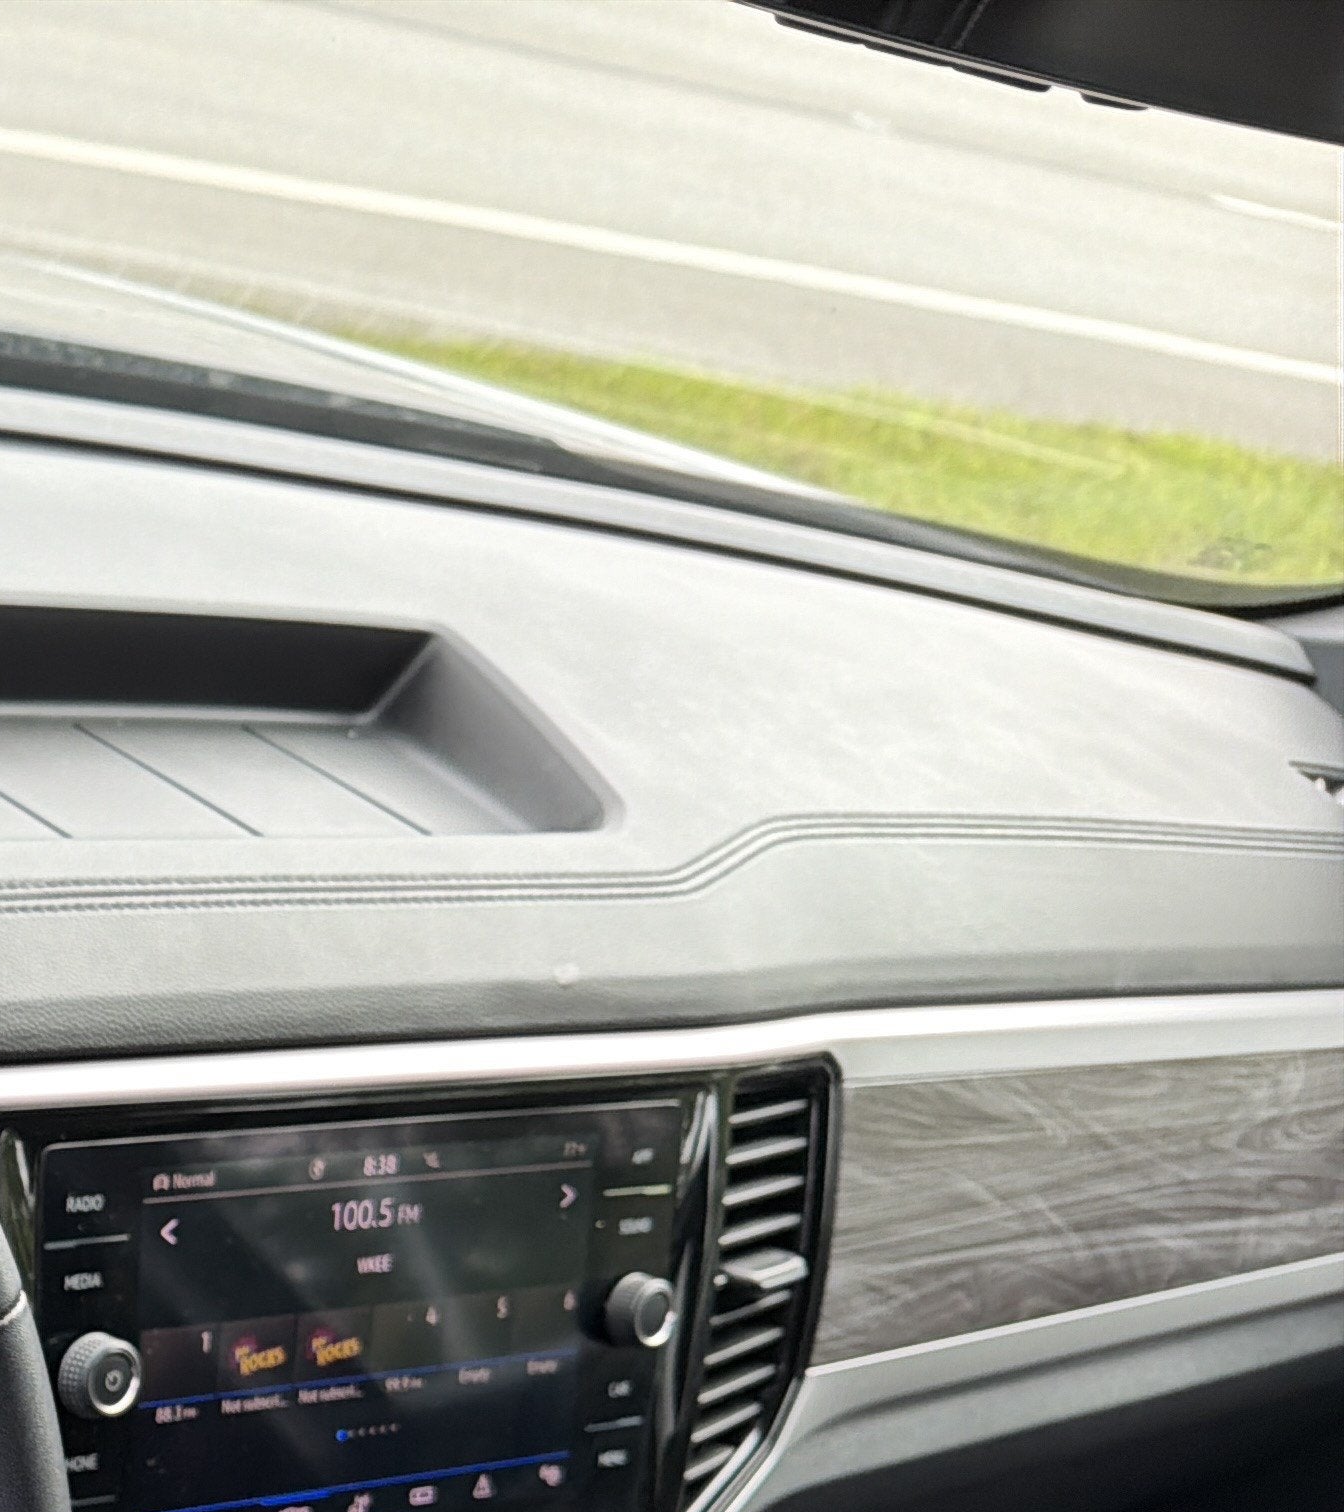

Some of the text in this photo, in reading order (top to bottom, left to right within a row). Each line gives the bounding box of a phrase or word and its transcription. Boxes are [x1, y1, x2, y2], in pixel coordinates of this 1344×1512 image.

[65, 1192, 105, 1213] RADIO
[332, 1197, 422, 1232] 100.5 FM
[63, 1271, 104, 1291] MEDIA
